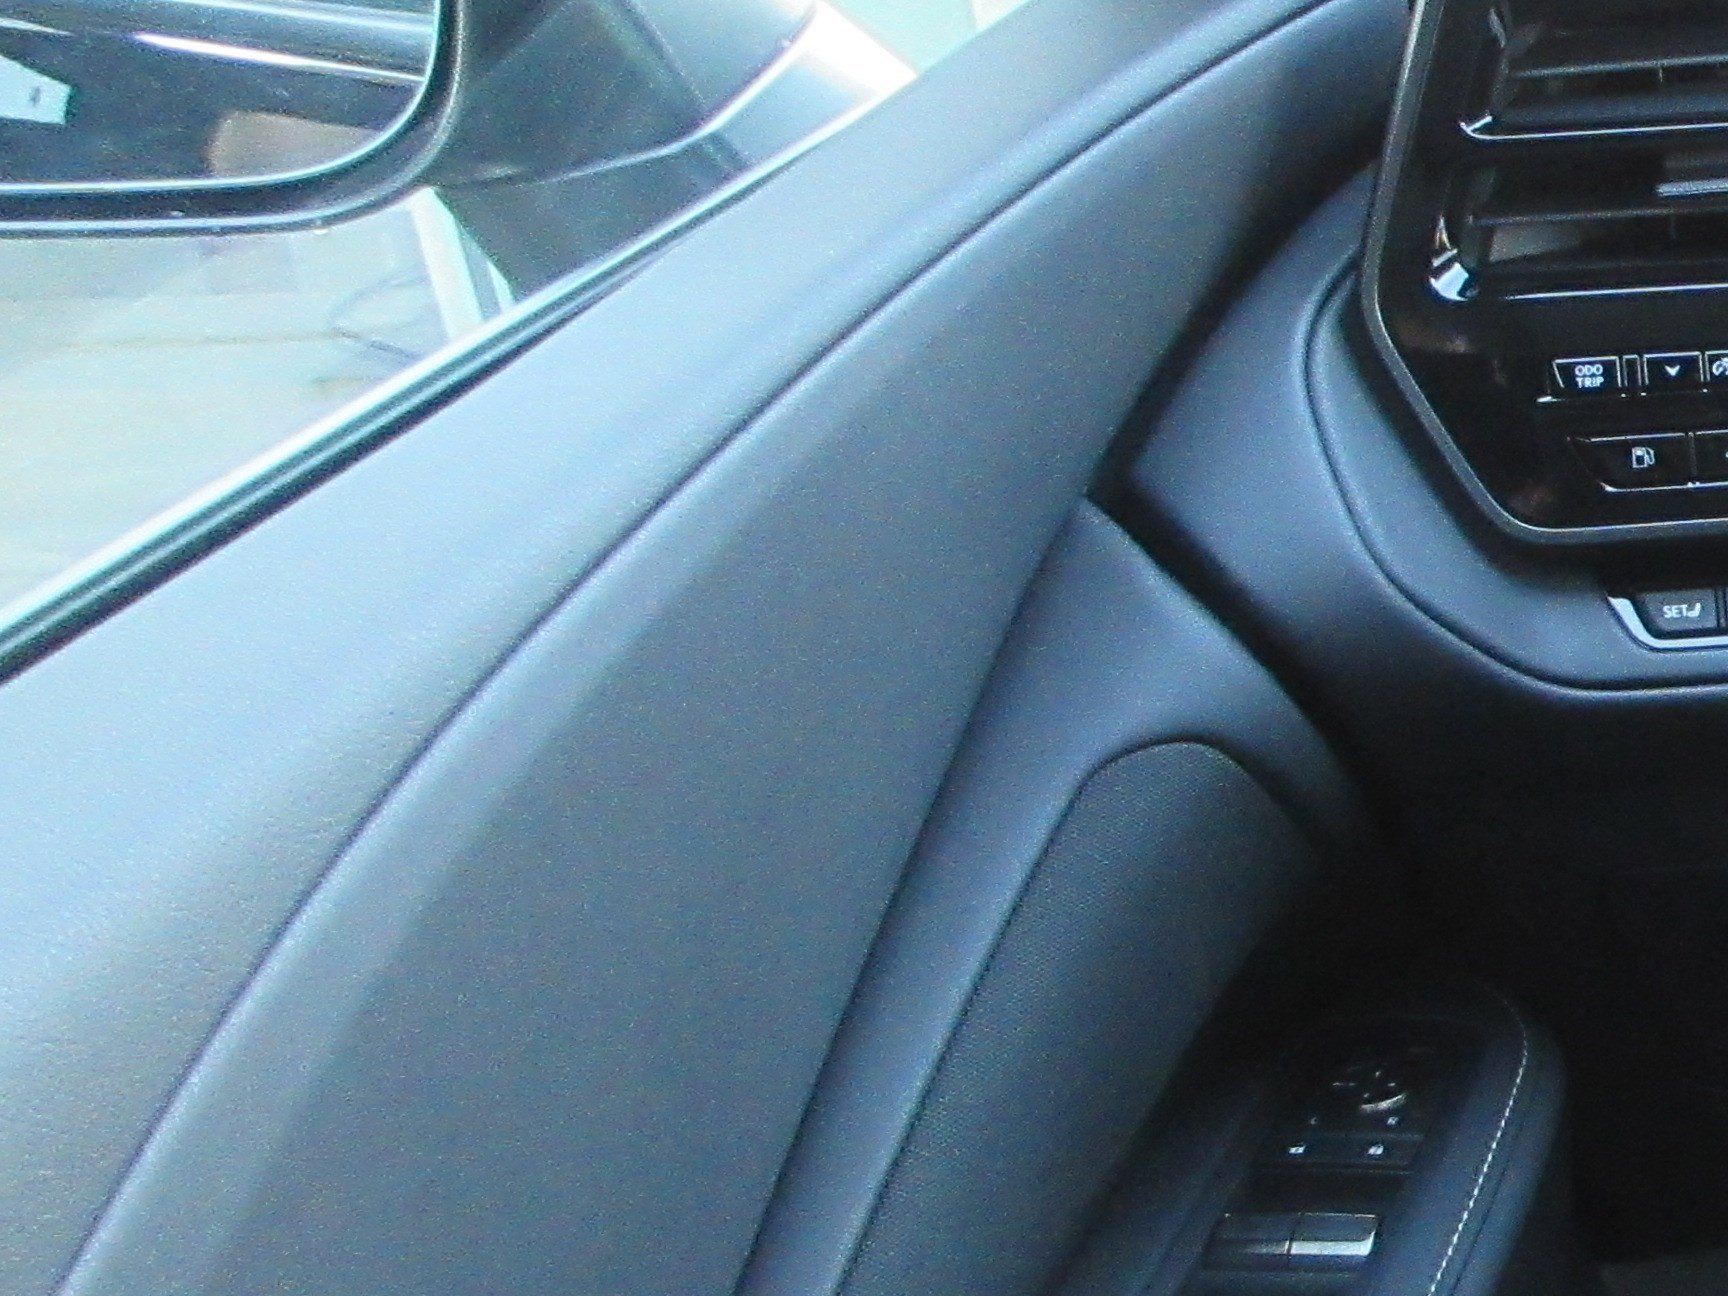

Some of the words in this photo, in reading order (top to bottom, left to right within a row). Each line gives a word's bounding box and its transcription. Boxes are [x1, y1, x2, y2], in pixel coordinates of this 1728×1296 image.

[1575, 364, 1603, 376] ODO
[1575, 376, 1604, 389] TRIP
[1662, 605, 1688, 618] SET
